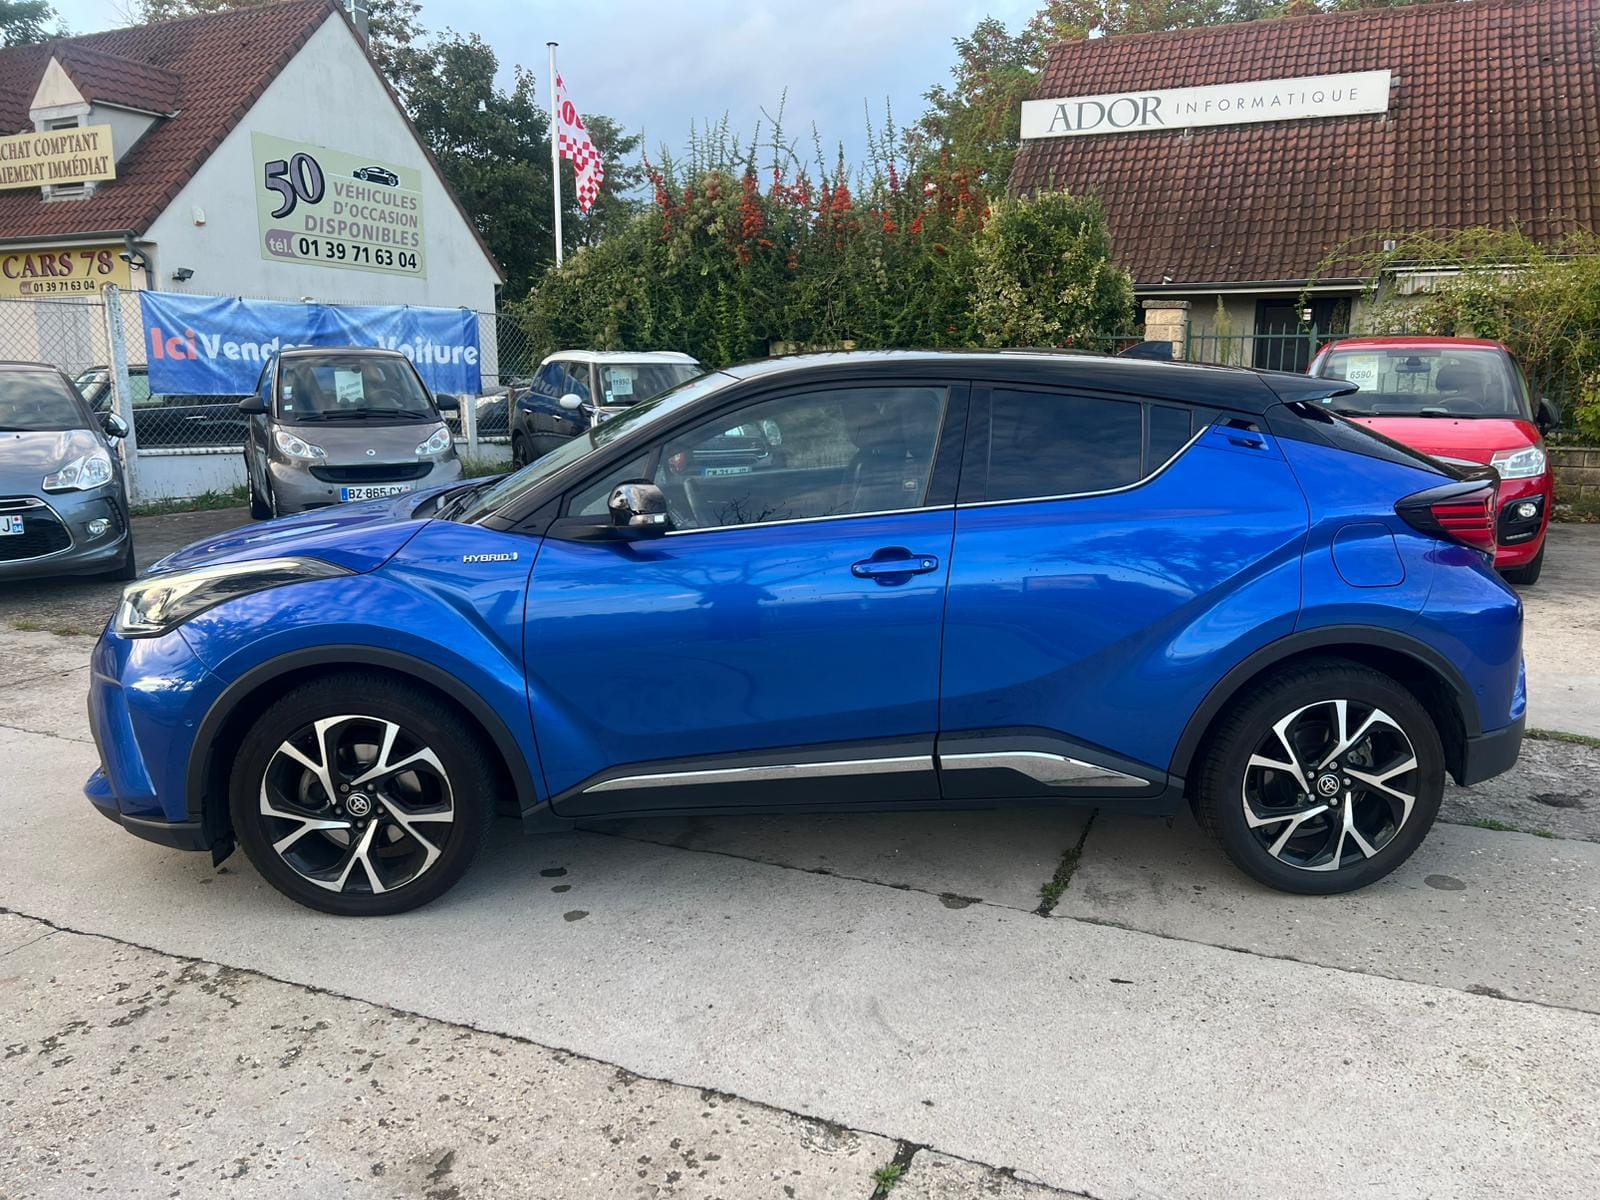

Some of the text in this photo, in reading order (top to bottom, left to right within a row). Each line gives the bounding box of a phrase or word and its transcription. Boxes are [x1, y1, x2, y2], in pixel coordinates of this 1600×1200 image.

[1046, 88, 1358, 133] ADOR INFORMATIQUE
[0, 132, 98, 161] CHAT COMPTANT
[47, 153, 108, 179] IMMÉDIAT
[265, 152, 325, 219] 50
[333, 181, 417, 210] VÉHICULES
[333, 201, 418, 228] D'OCCASION
[304, 214, 419, 247] DISPONIBLES
[2, 250, 114, 279] CARS 78
[268, 237, 417, 269] tél. 01 39 71 63 04
[33, 282, 43, 293] 01
[46, 281, 57, 292] 39
[59, 281, 68, 291] 71
[71, 280, 81, 291] 63
[83, 280, 95, 290] 04
[151, 327, 198, 360] Ici
[200, 333, 314, 361] Vend
[463, 553, 509, 563] HYBRID
